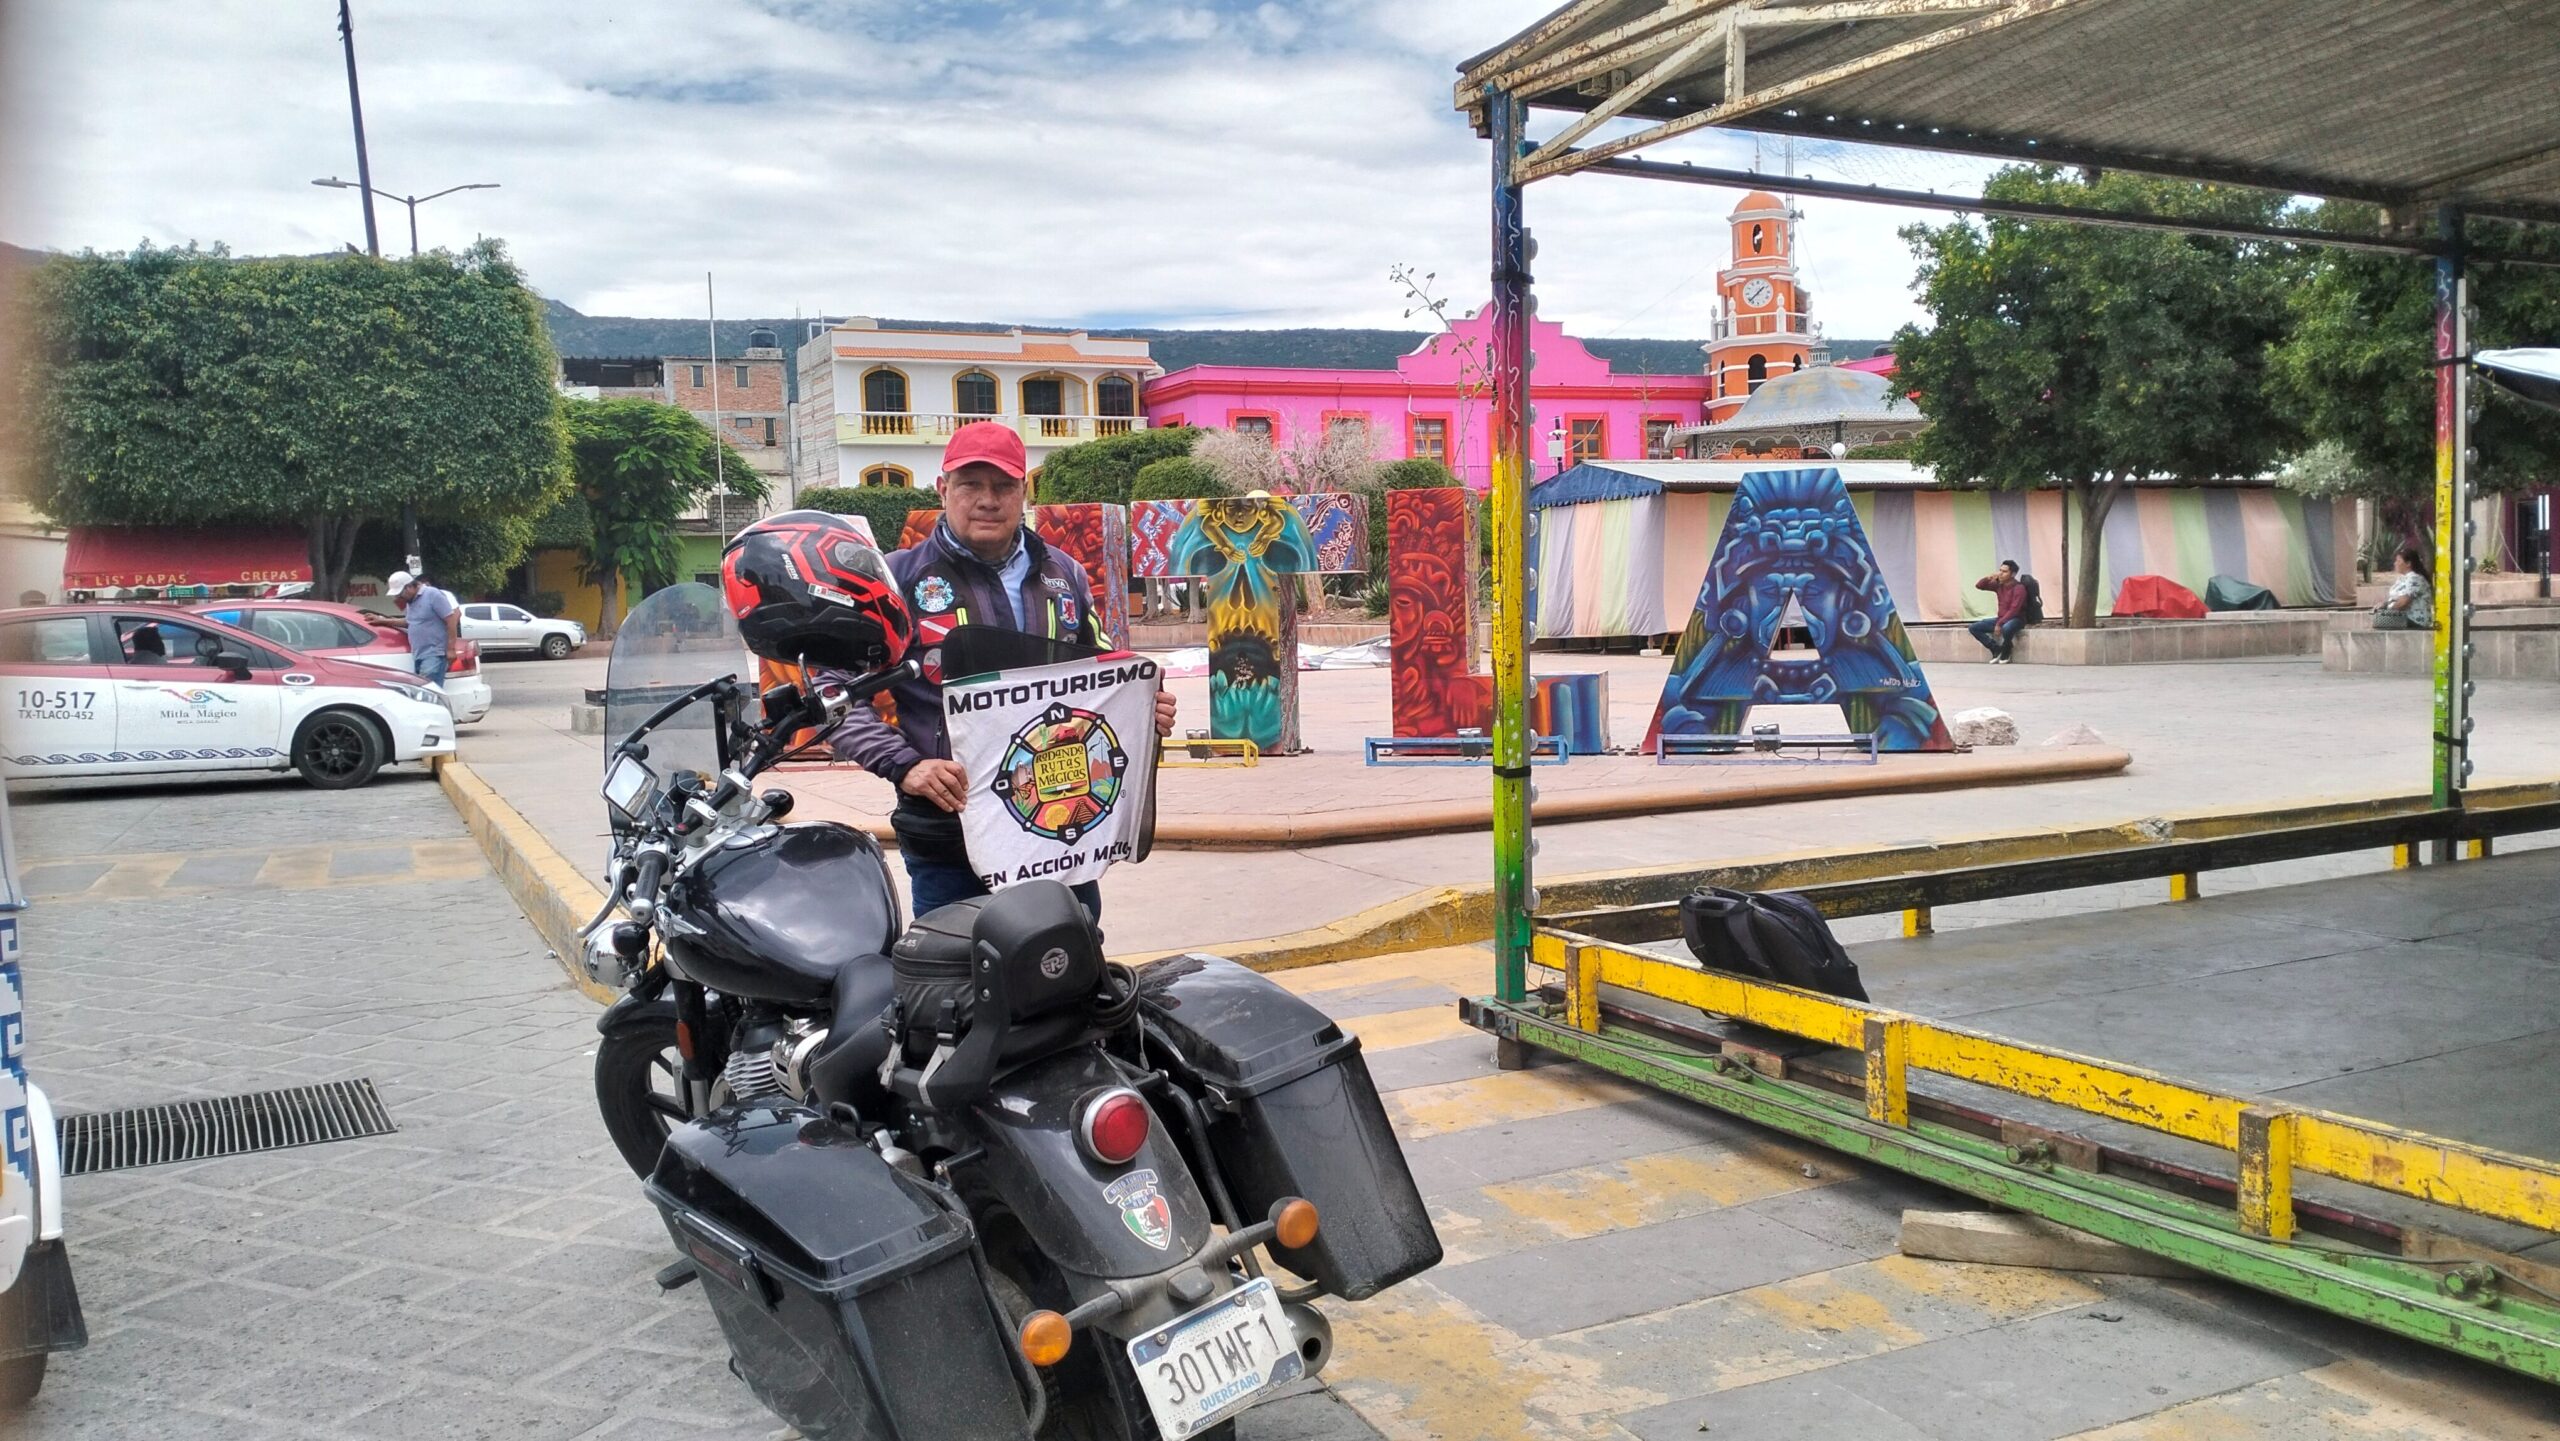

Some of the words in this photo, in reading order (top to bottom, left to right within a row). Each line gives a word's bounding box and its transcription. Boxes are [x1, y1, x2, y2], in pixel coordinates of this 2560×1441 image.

[134, 573, 188, 585] PAPAS
[240, 569, 299, 582] CREPAS
[949, 661, 1158, 716] MOTOTURISMO
[18, 691, 96, 709] 10-517
[18, 710, 94, 720] TX-TLACO-452
[160, 710, 190, 719] Mitla
[197, 709, 237, 719] Mágico
[1050, 708, 1065, 721] N
[1113, 756, 1124, 768] E
[995, 780, 1009, 791] O
[1065, 828, 1077, 839] S
[981, 871, 1007, 888] EN
[1016, 850, 1086, 881] ACCIÓN
[1200, 1372, 1260, 1412] QUERÉTARO
